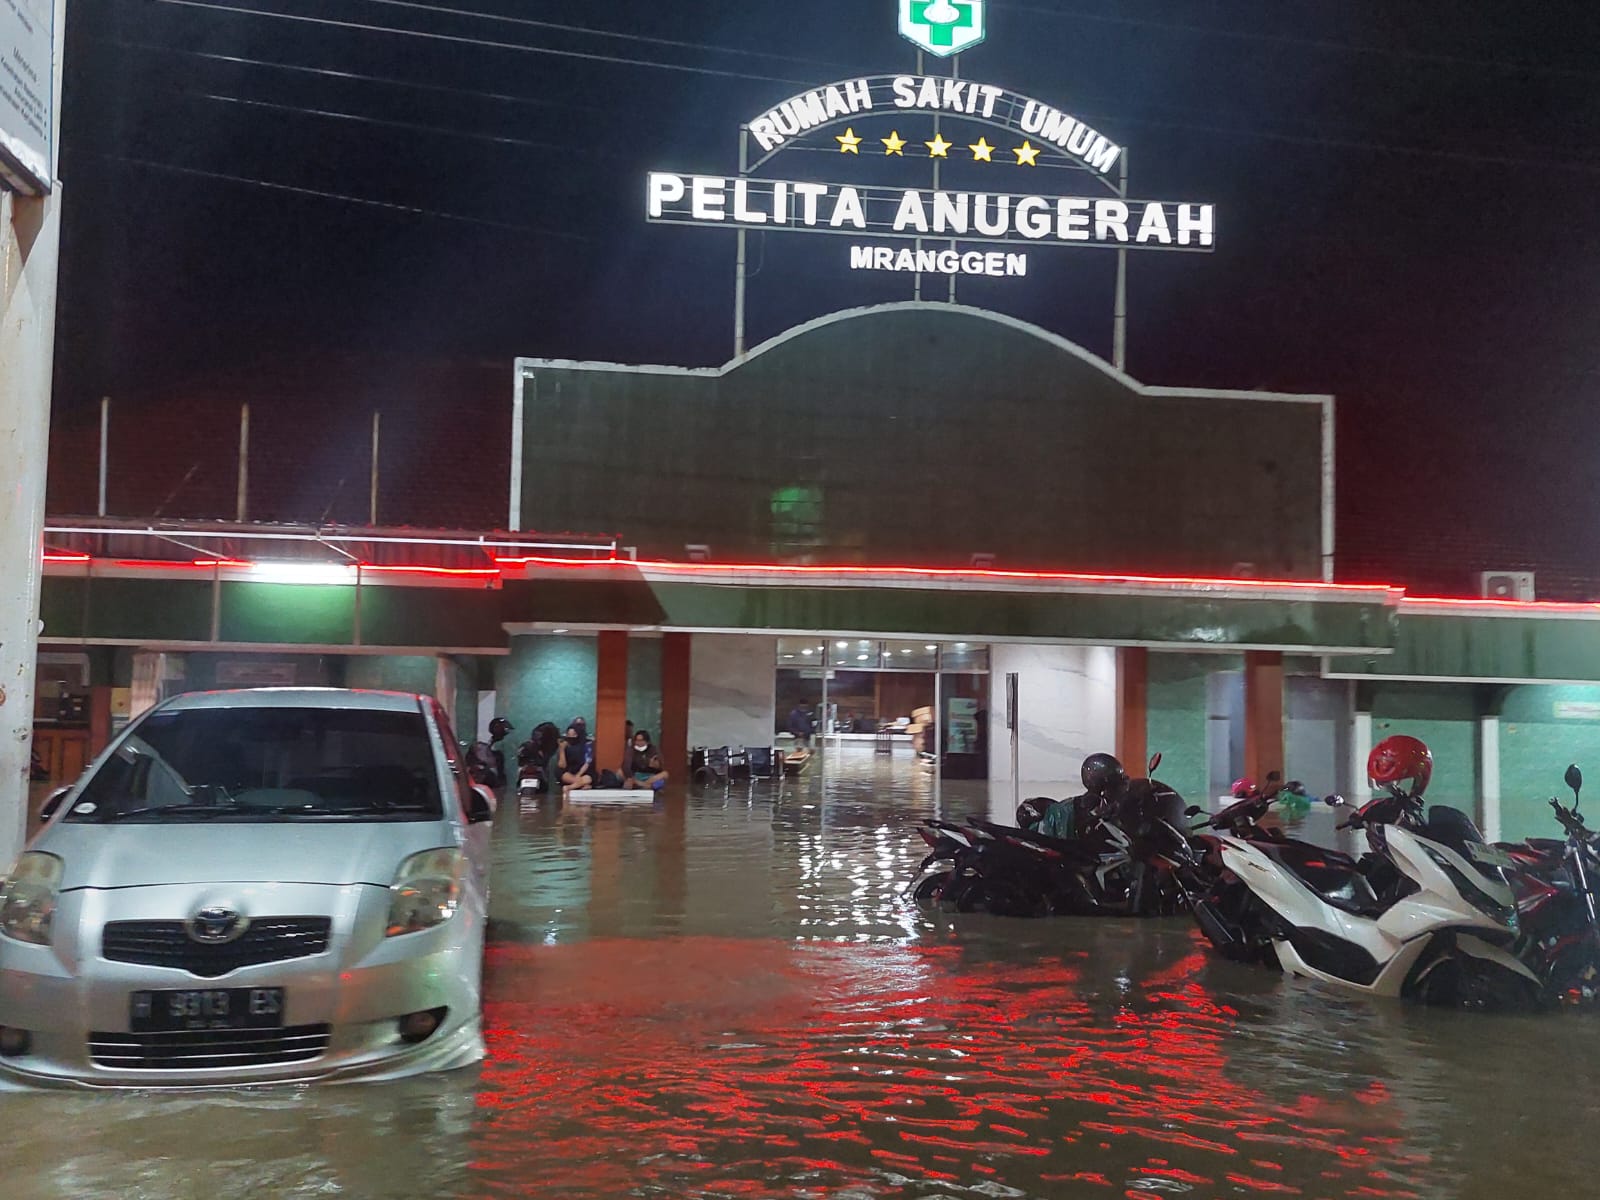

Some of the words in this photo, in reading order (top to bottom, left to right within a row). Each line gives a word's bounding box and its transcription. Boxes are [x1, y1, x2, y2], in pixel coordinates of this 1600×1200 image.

[748, 79, 873, 151] RUMAH
[891, 75, 1004, 118] SAKIT
[1020, 100, 1123, 174] UMUM
[649, 173, 867, 228] PELITA
[892, 190, 1214, 246] ANUGERAH
[850, 246, 1028, 276] MRANGGEN
